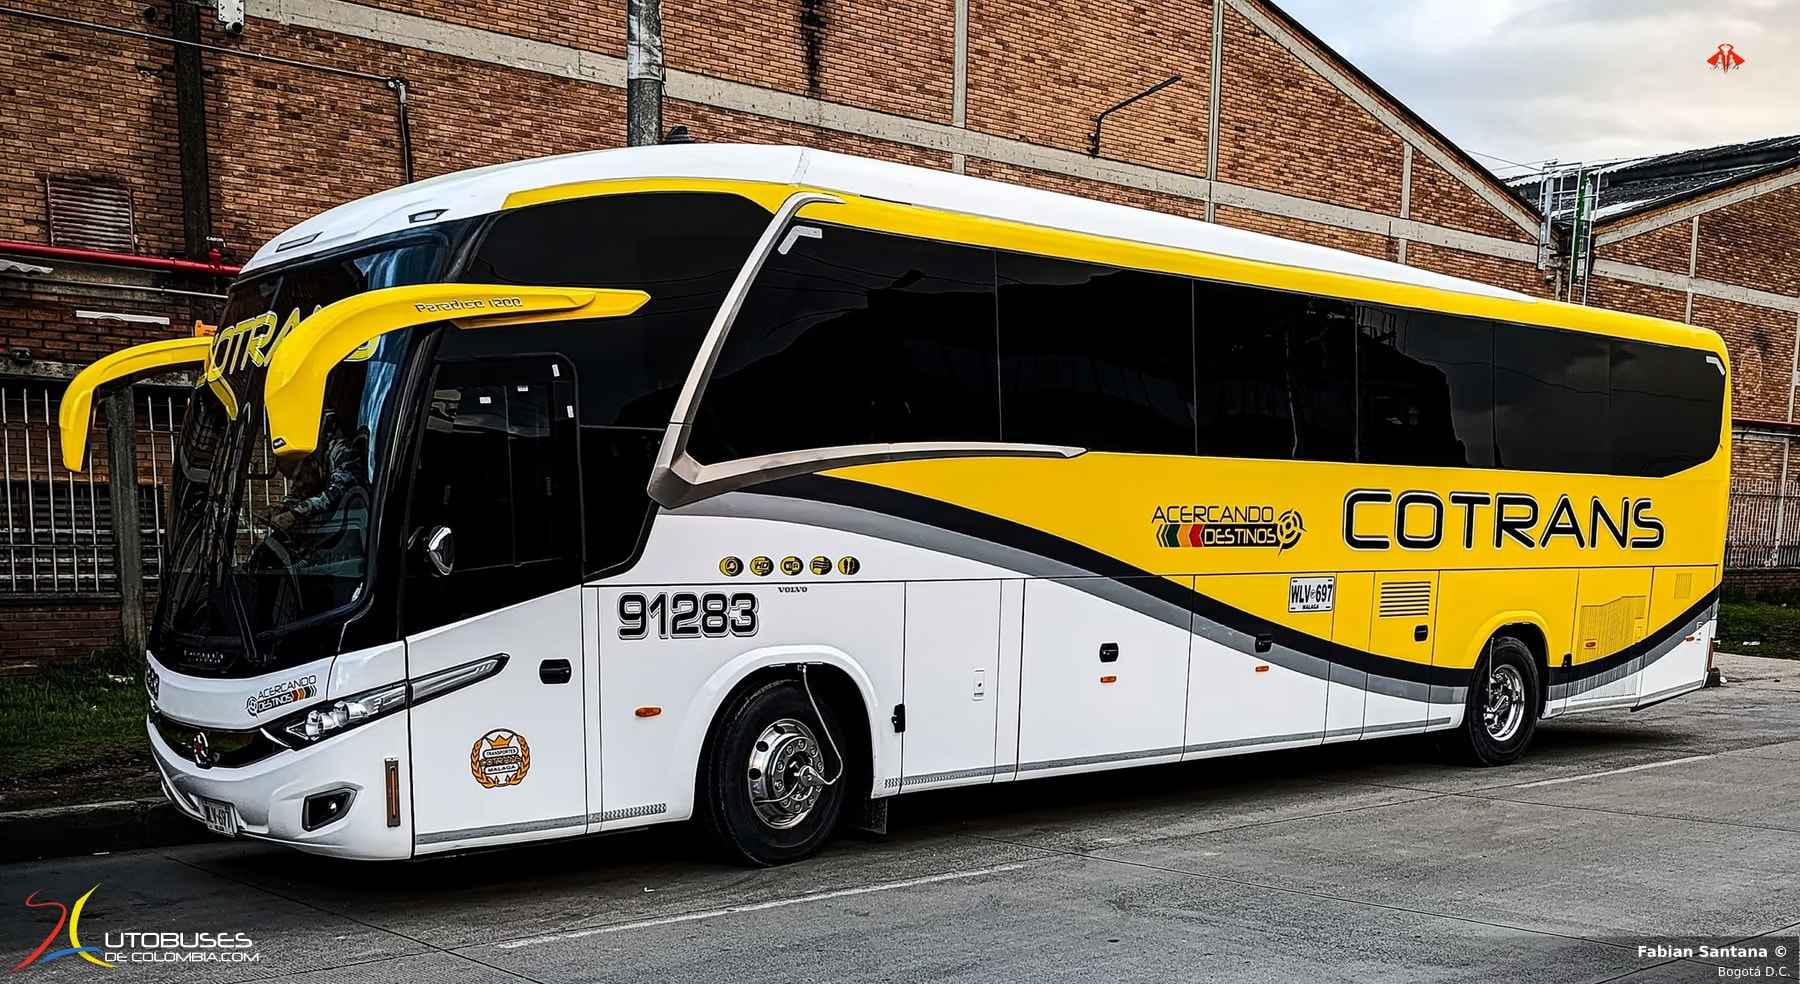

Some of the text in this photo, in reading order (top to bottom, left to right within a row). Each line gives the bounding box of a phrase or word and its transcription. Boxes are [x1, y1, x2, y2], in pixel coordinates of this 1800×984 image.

[415, 297, 523, 313] Paradiso 1200
[1151, 505, 1274, 524] ACERCANDO
[1343, 488, 1666, 551] COTRANS
[1204, 527, 1277, 545] DESTINOS
[617, 591, 759, 640] 91283
[257, 674, 317, 700] ACERCANDO
[258, 692, 293, 712] DESTINOS
[486, 748, 516, 757] TRANSPORTES
[487, 764, 516, 772] MALAGA
